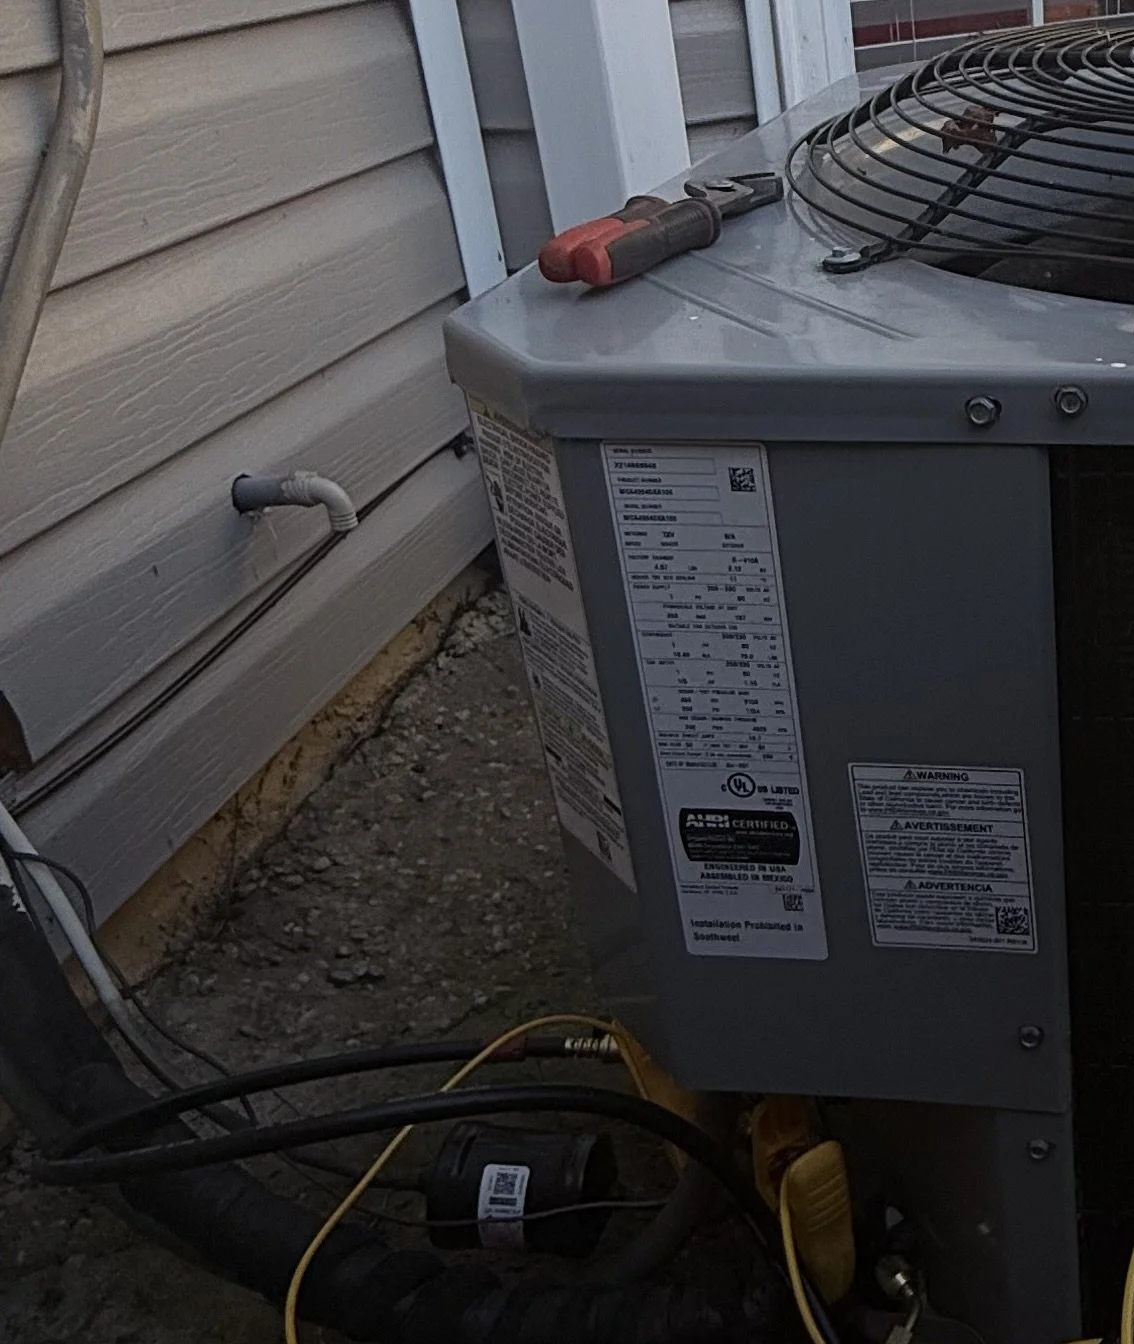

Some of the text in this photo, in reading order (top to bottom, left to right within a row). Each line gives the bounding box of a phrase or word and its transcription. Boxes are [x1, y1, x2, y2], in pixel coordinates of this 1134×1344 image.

[917, 771, 970, 782] WARNING
[771, 785, 800, 795] LISTED
[732, 818, 789, 831] CERTIFIED
[904, 821, 994, 833] AVERTISSEMENT
[704, 862, 786, 873] ENGINEERED IN USA
[700, 872, 793, 883] ASSEMBLED IN MEXICO
[918, 882, 993, 893] ADVERTENCIA
[690, 918, 803, 932] Installation Prohibited in
[693, 931, 740, 943] Southwest
